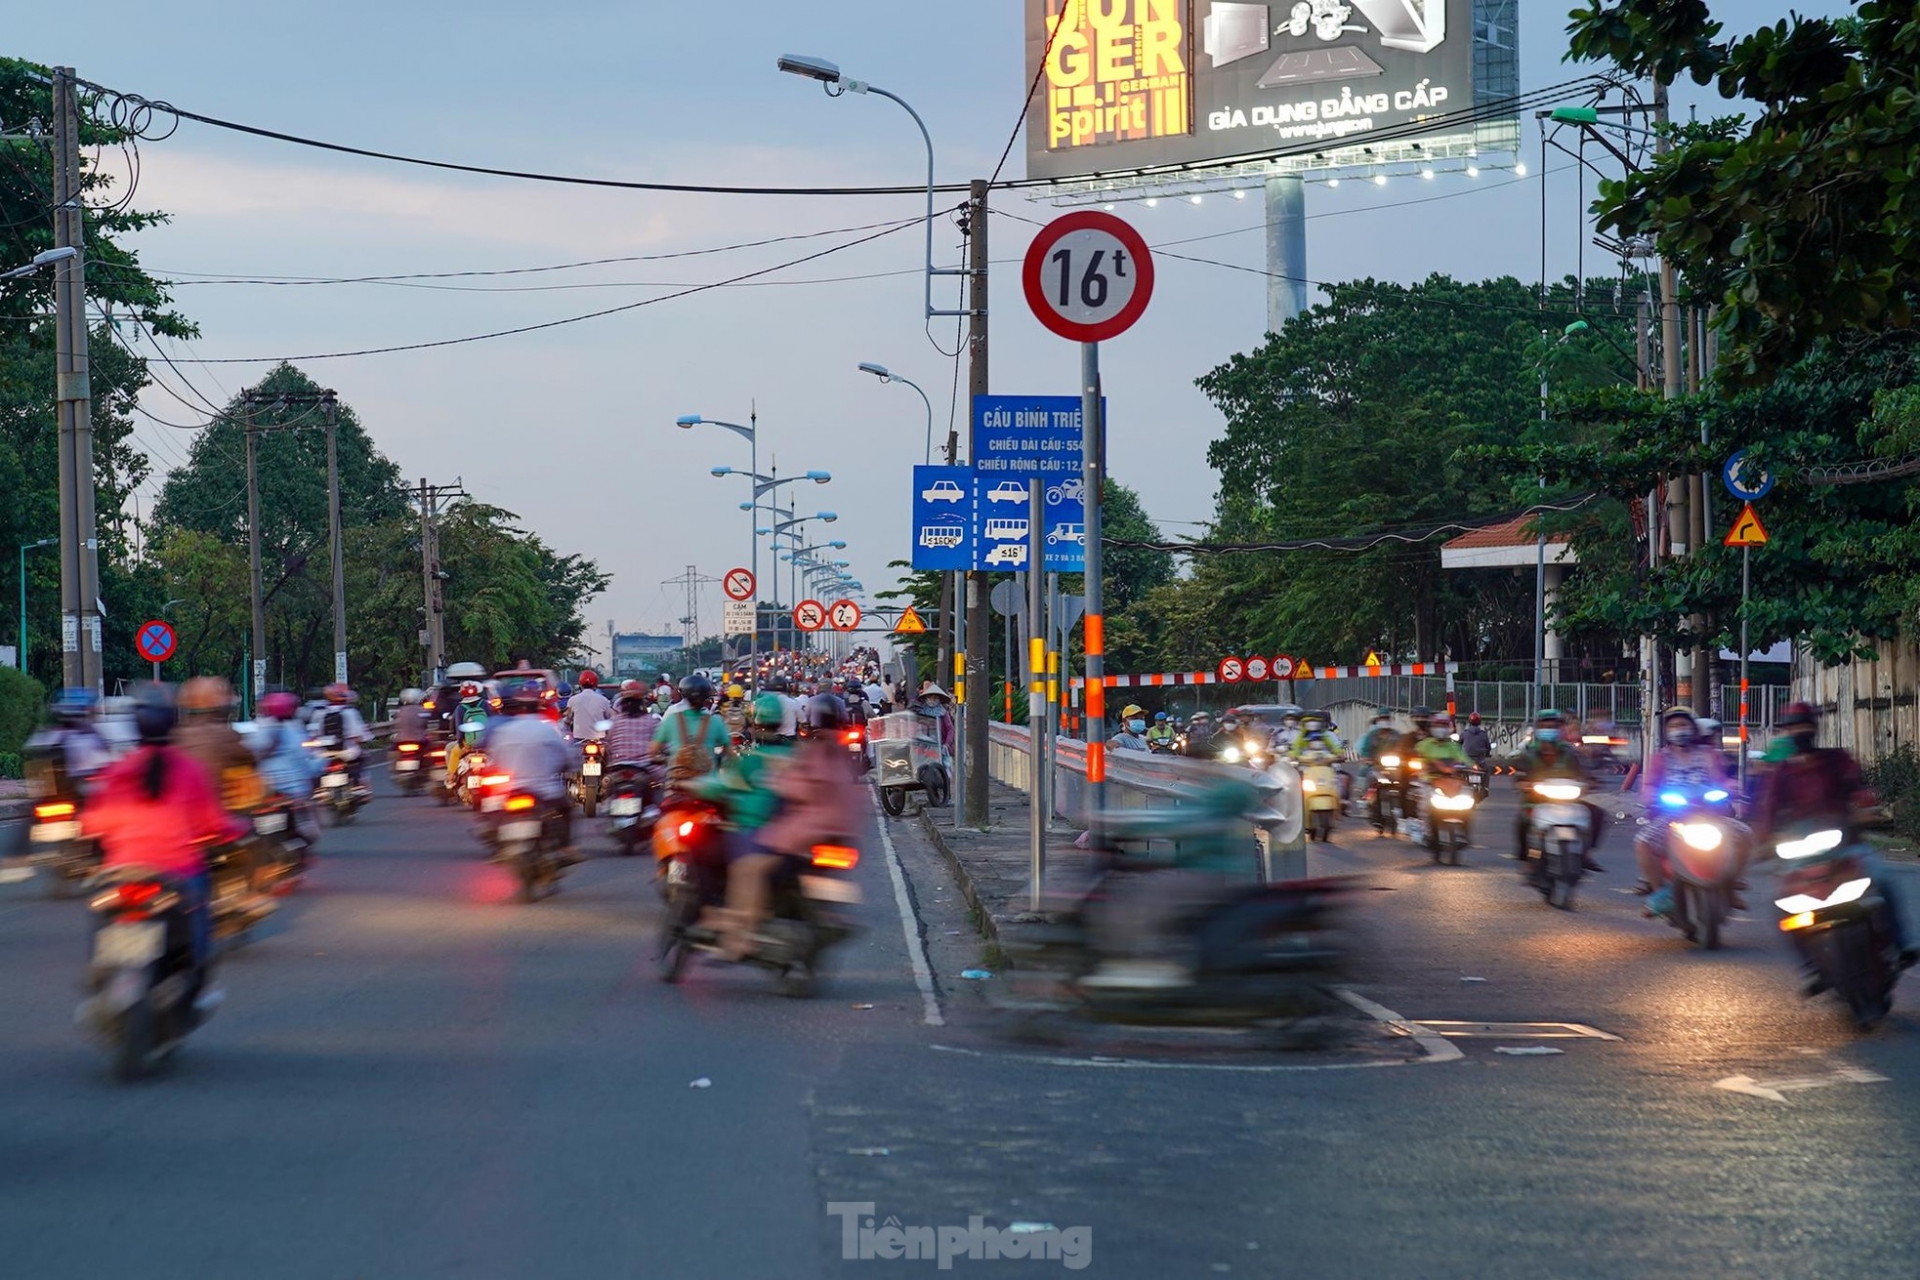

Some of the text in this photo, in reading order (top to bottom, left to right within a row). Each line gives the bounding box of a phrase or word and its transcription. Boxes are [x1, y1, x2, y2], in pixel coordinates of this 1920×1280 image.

[1045, 20, 1186, 88] GER
[1120, 75, 1179, 93] GERMAN
[1394, 78, 1448, 110] CẤP
[1054, 95, 1146, 146] spirit
[983, 405, 1011, 428] CẦU
[1015, 407, 1048, 428] BÌNH
[1010, 457, 1037, 473] RỘNG
